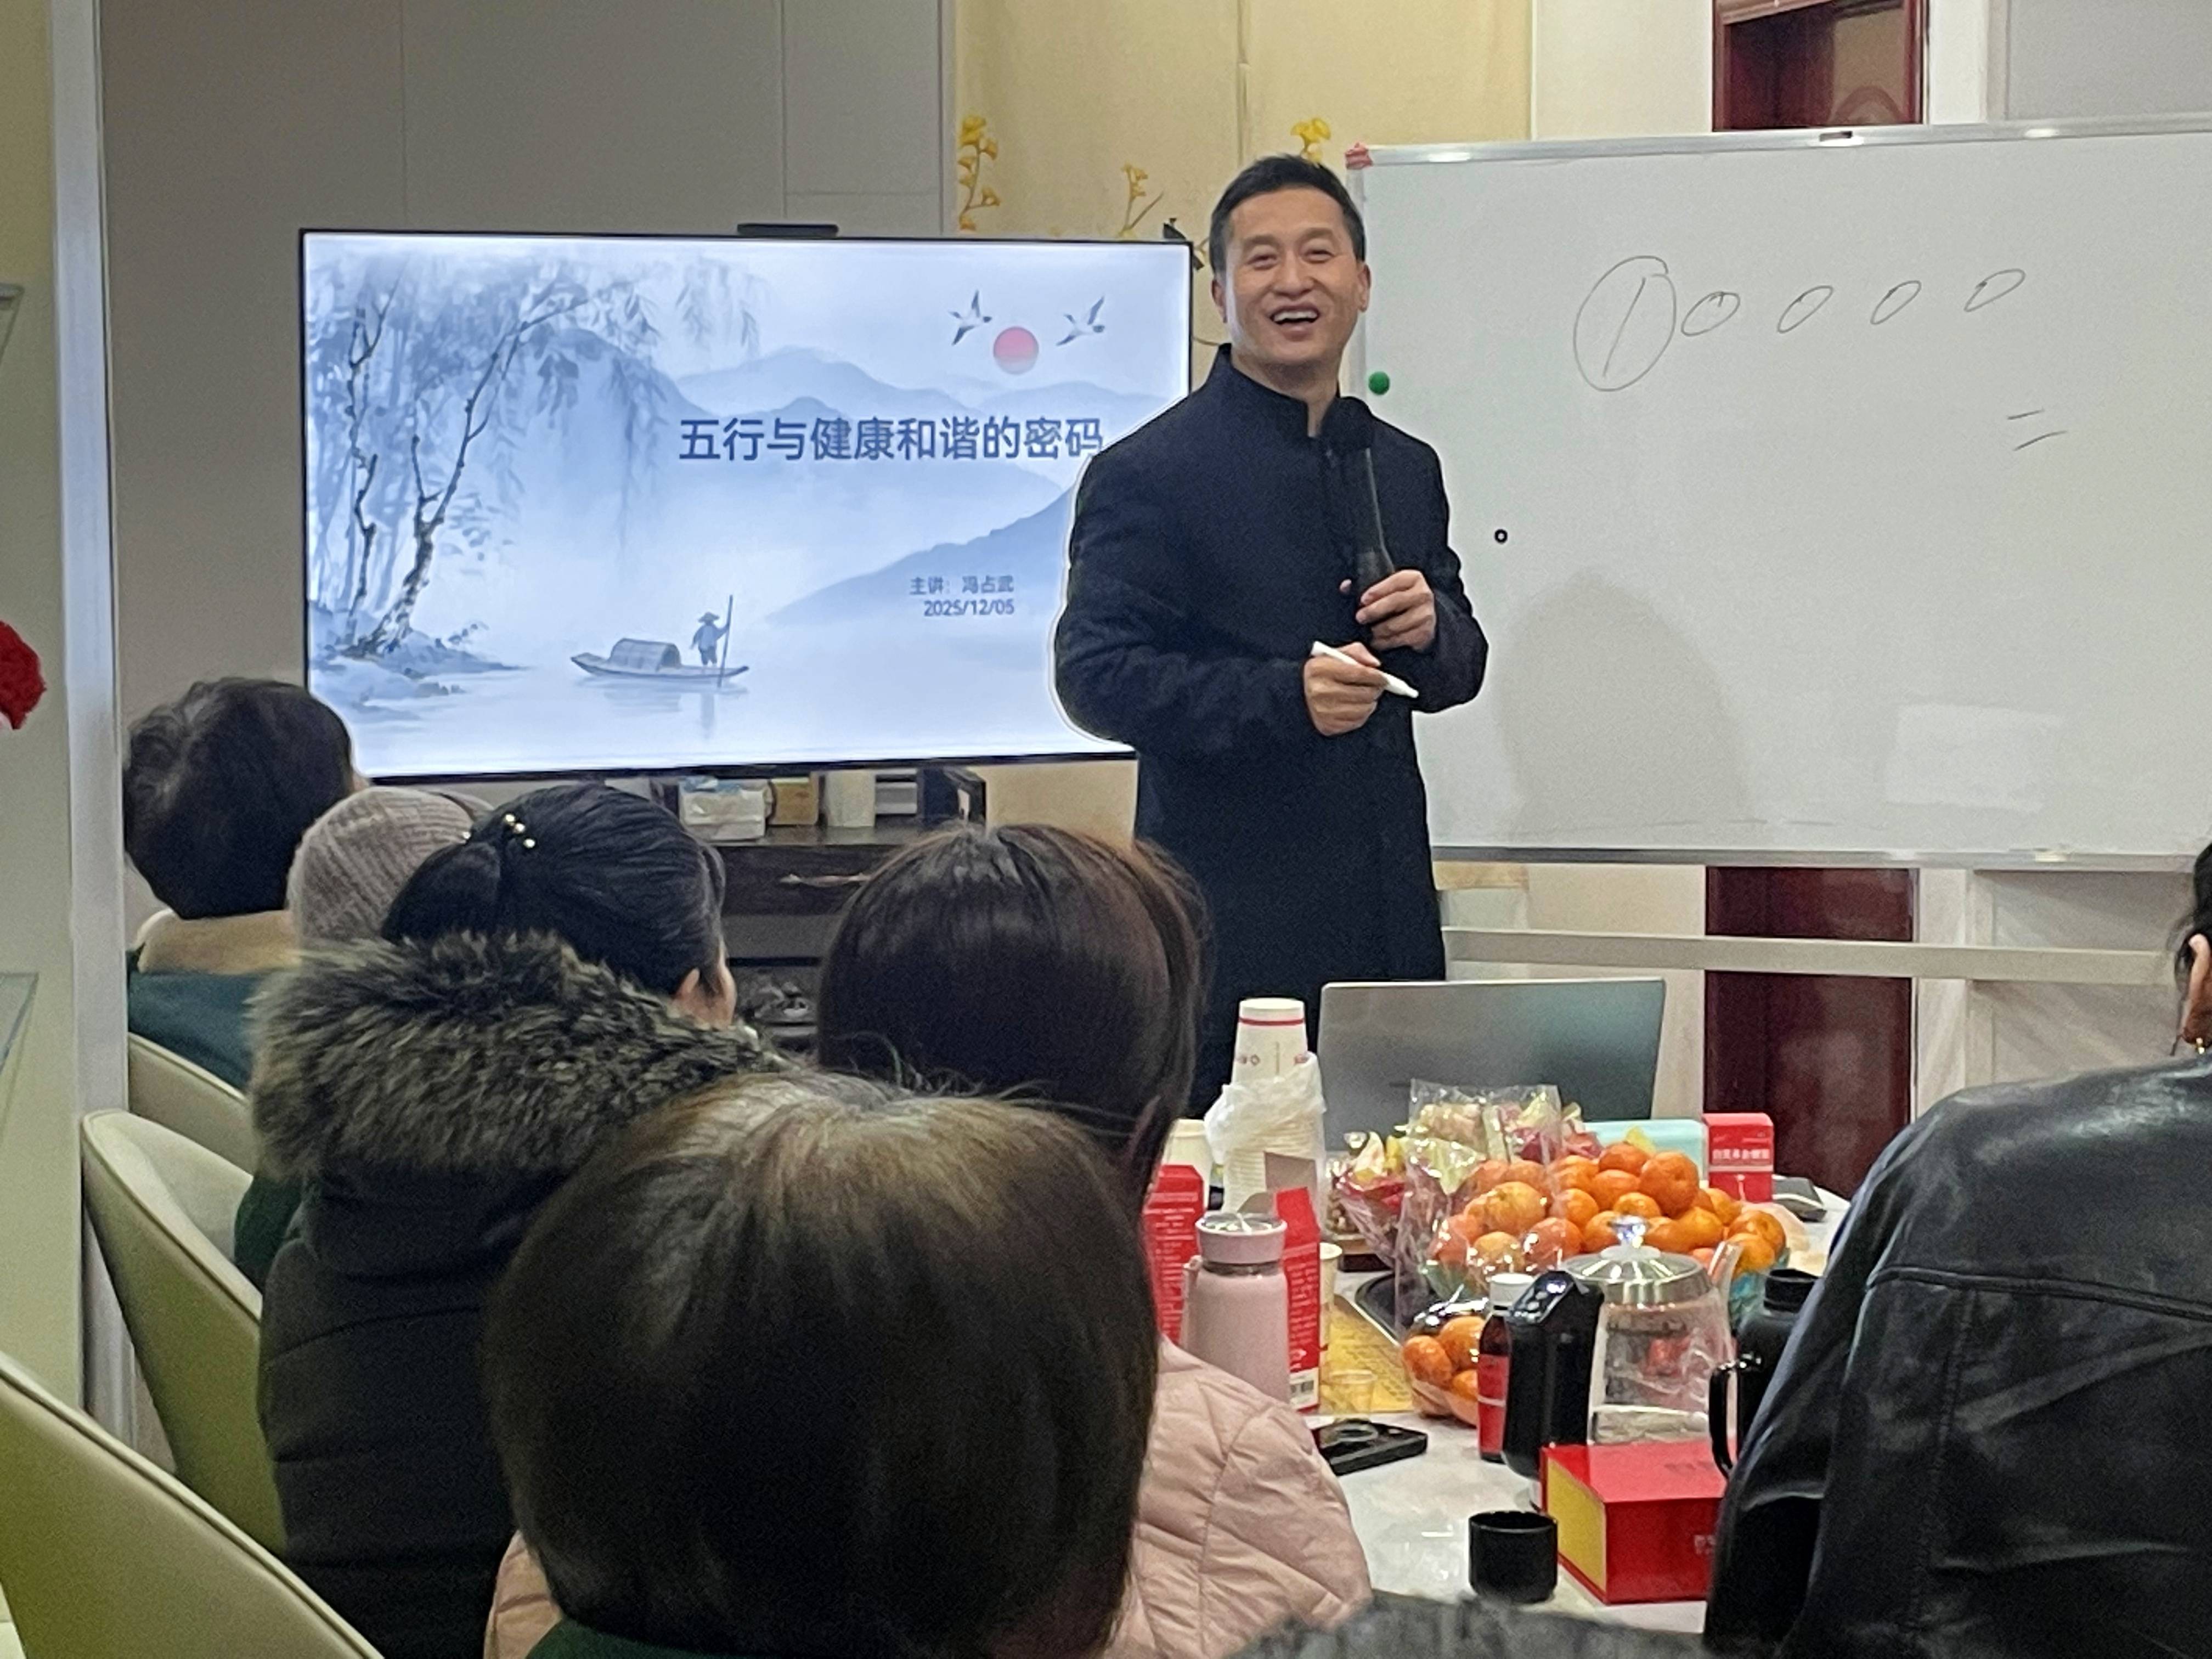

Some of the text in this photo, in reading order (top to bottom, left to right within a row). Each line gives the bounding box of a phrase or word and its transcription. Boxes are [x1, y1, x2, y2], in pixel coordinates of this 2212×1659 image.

[679, 415, 1103, 461] 五行与健康和谐的密码
[924, 598, 1014, 617] 2025/12/05
